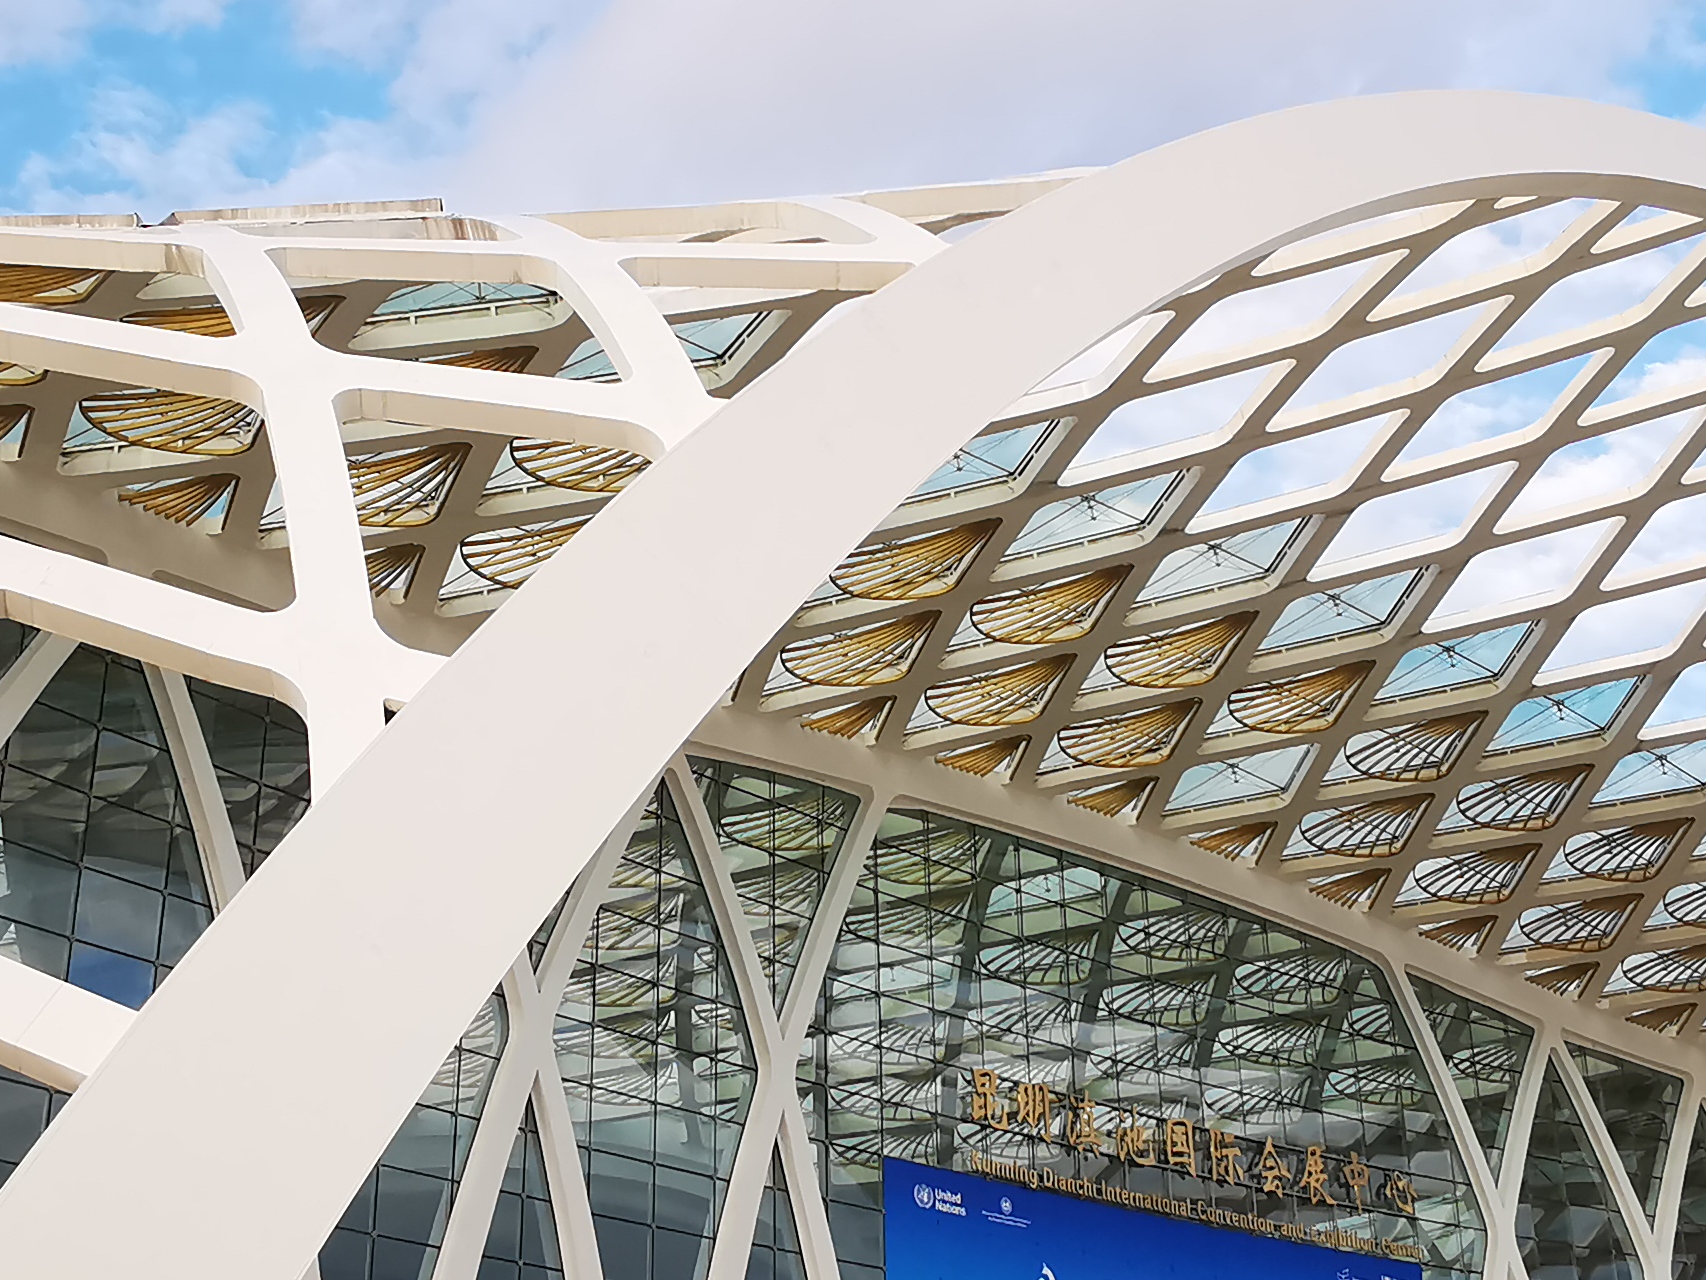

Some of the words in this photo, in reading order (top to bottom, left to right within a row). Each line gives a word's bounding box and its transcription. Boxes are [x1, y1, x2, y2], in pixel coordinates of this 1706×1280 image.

[972, 1069, 1418, 1214] 昆明滇池国际会展中心
[934, 1187, 962, 1205] United
[934, 1199, 967, 1217] Nations
[970, 1149, 1039, 1189] Kunming
[1043, 1167, 1097, 1197] Dianchi
[1101, 1180, 1192, 1217] International
[1197, 1201, 1276, 1234] Convention
[1281, 1223, 1305, 1240] and
